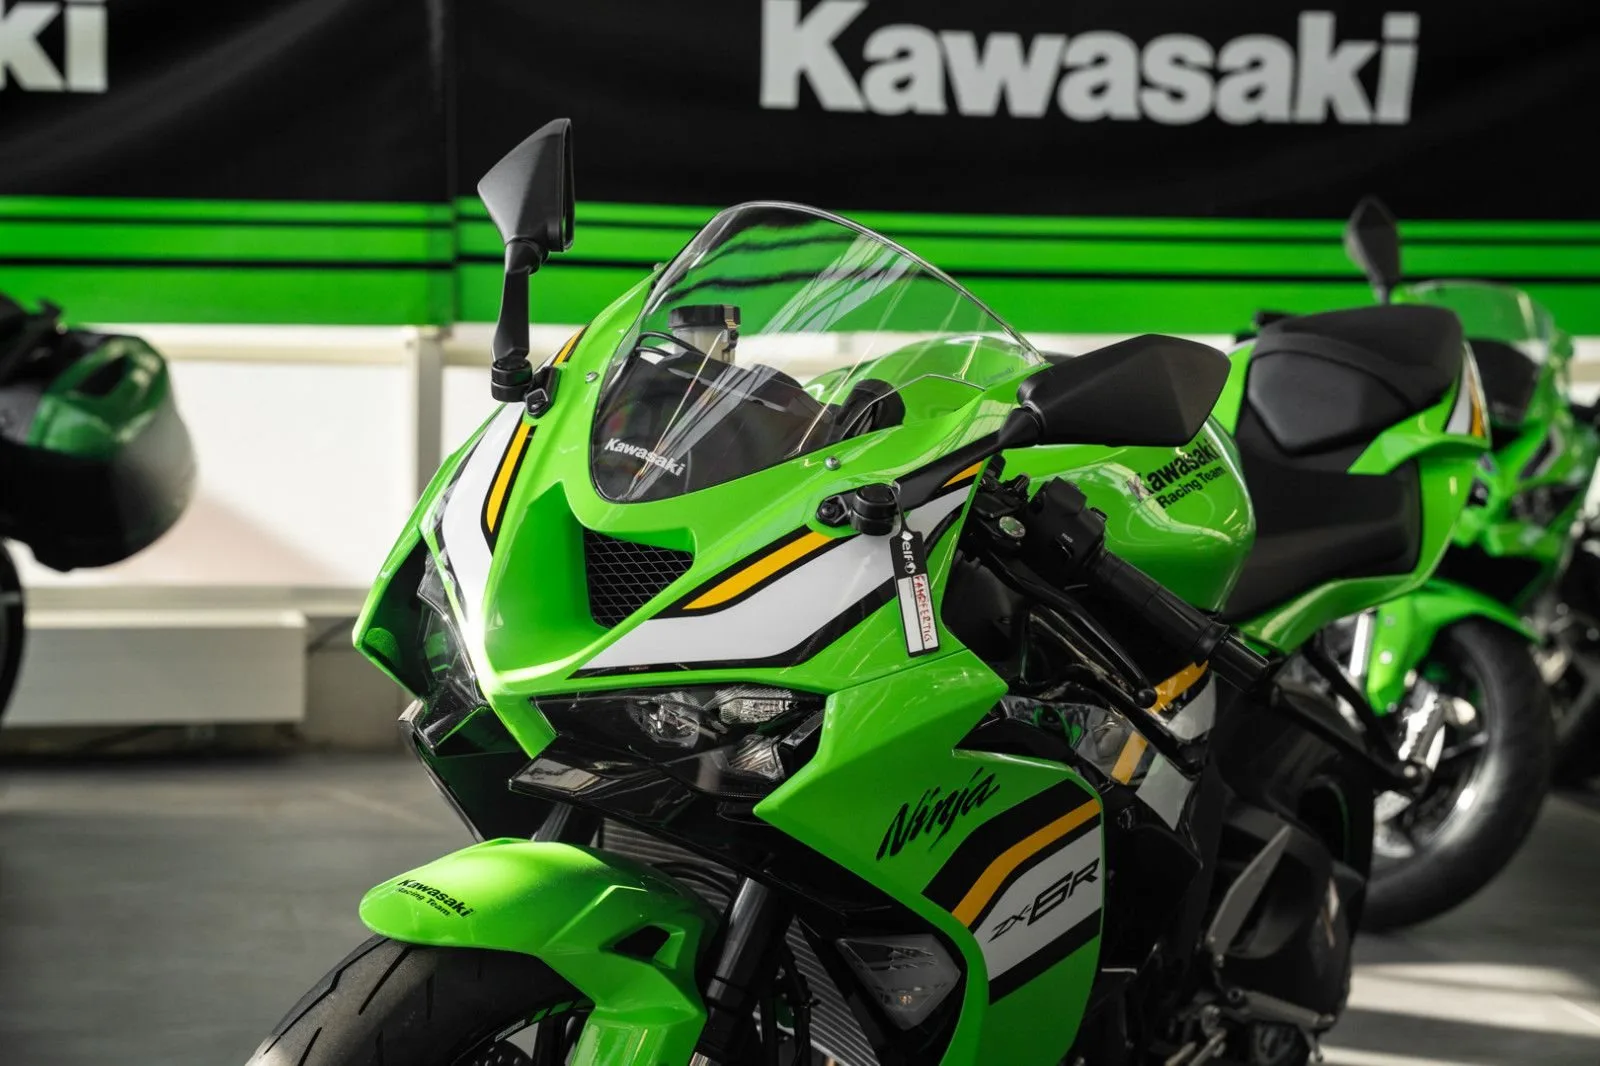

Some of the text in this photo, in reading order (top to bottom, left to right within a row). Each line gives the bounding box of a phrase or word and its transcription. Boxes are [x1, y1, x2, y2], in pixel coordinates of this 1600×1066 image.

[760, 0, 1420, 124] Kawasaki
[604, 438, 686, 476] Kawasaki
[1126, 438, 1220, 503] Kawasaki
[1156, 466, 1226, 509] Racing Team
[902, 542, 915, 561] elf
[876, 767, 1000, 861] Ninja
[397, 879, 474, 917] Kawasaki
[427, 898, 451, 916] Team
[988, 857, 1100, 943] ZX-6R
